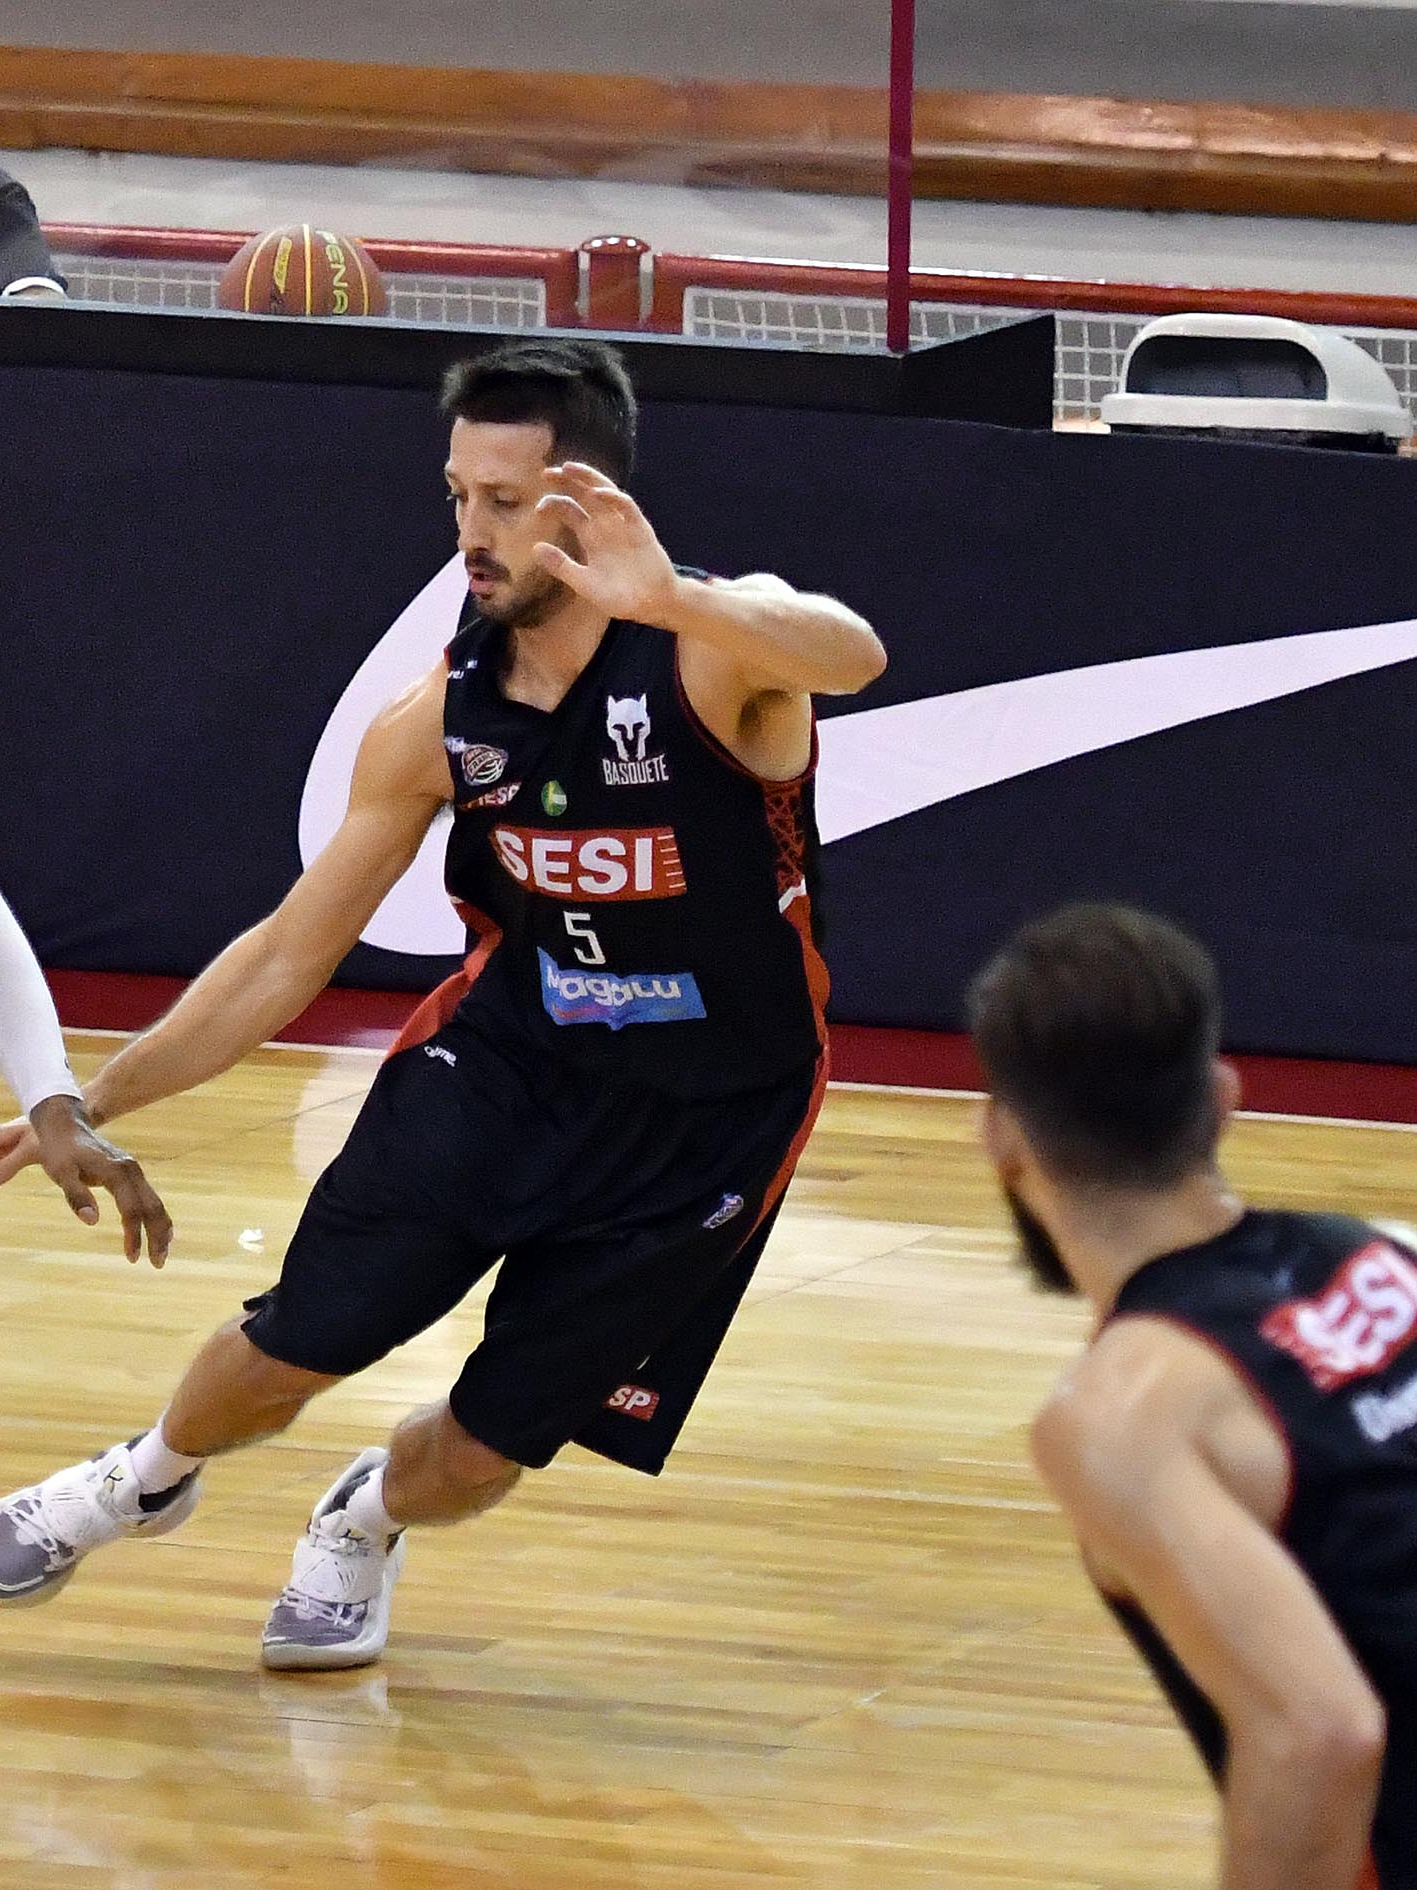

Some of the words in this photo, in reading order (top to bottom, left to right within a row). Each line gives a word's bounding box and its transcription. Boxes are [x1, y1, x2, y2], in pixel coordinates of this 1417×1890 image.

[602, 755, 670, 786] BASQUETE
[494, 830, 653, 894] SESI
[563, 911, 606, 965] 5
[609, 1387, 651, 1411] SP
